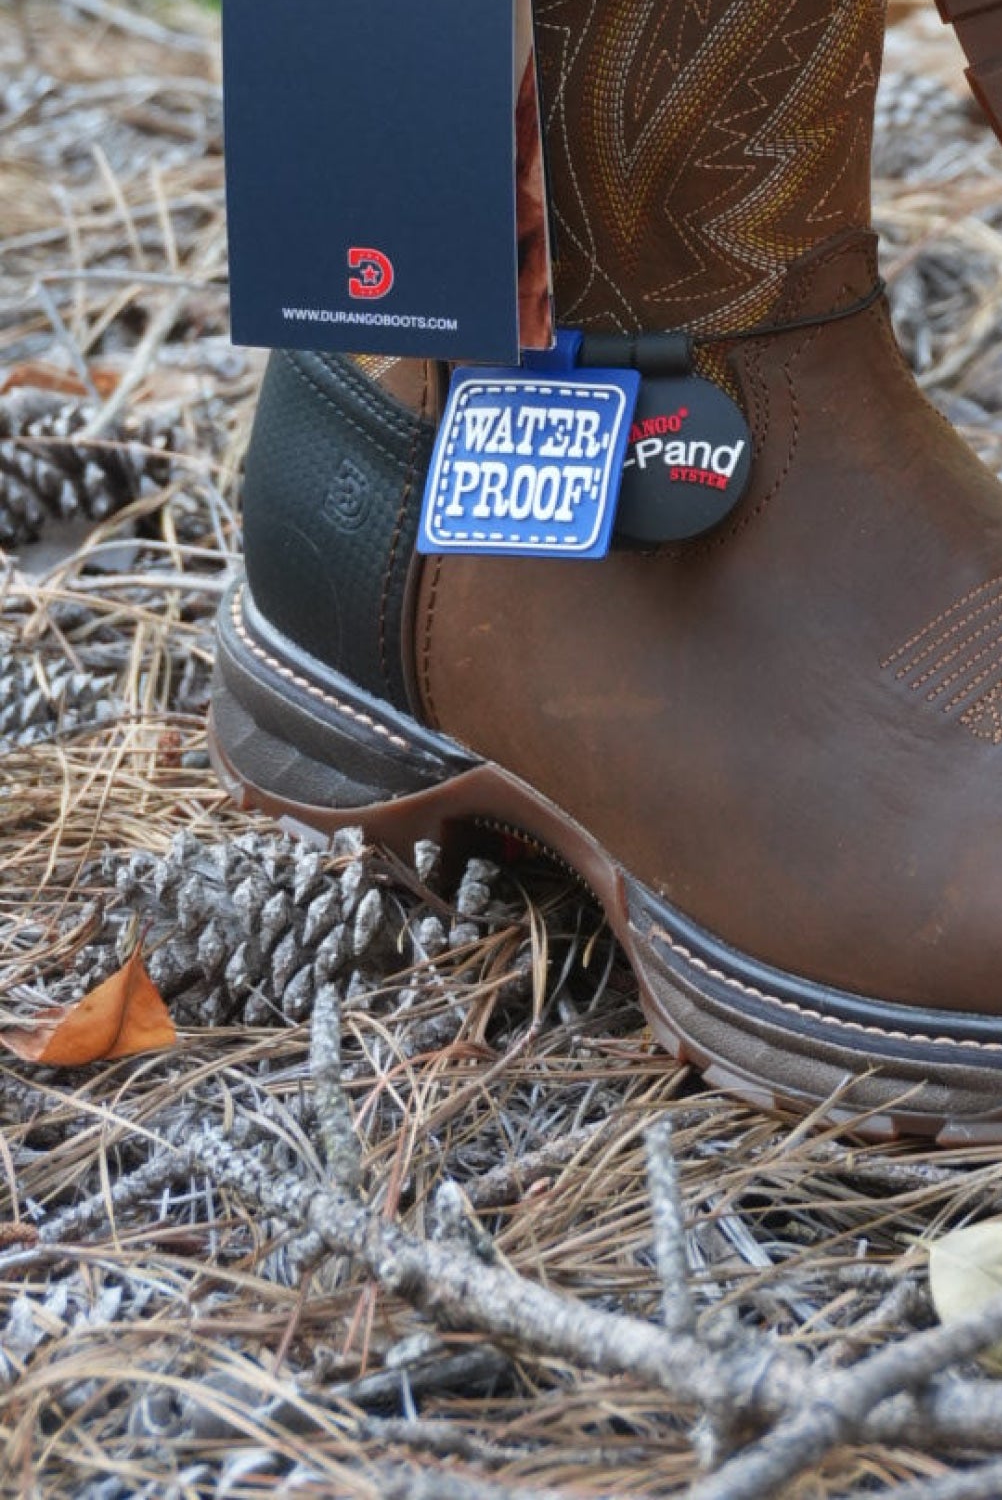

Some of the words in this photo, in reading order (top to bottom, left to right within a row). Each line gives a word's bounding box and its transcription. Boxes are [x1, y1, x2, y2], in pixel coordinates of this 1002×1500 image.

[281, 306, 458, 331] WWW.DURANGOBOOTS.COM
[463, 406, 602, 458] WATER
[629, 413, 683, 442] ANGO
[445, 461, 591, 522] PROOF
[669, 466, 729, 491] SYSTEM
